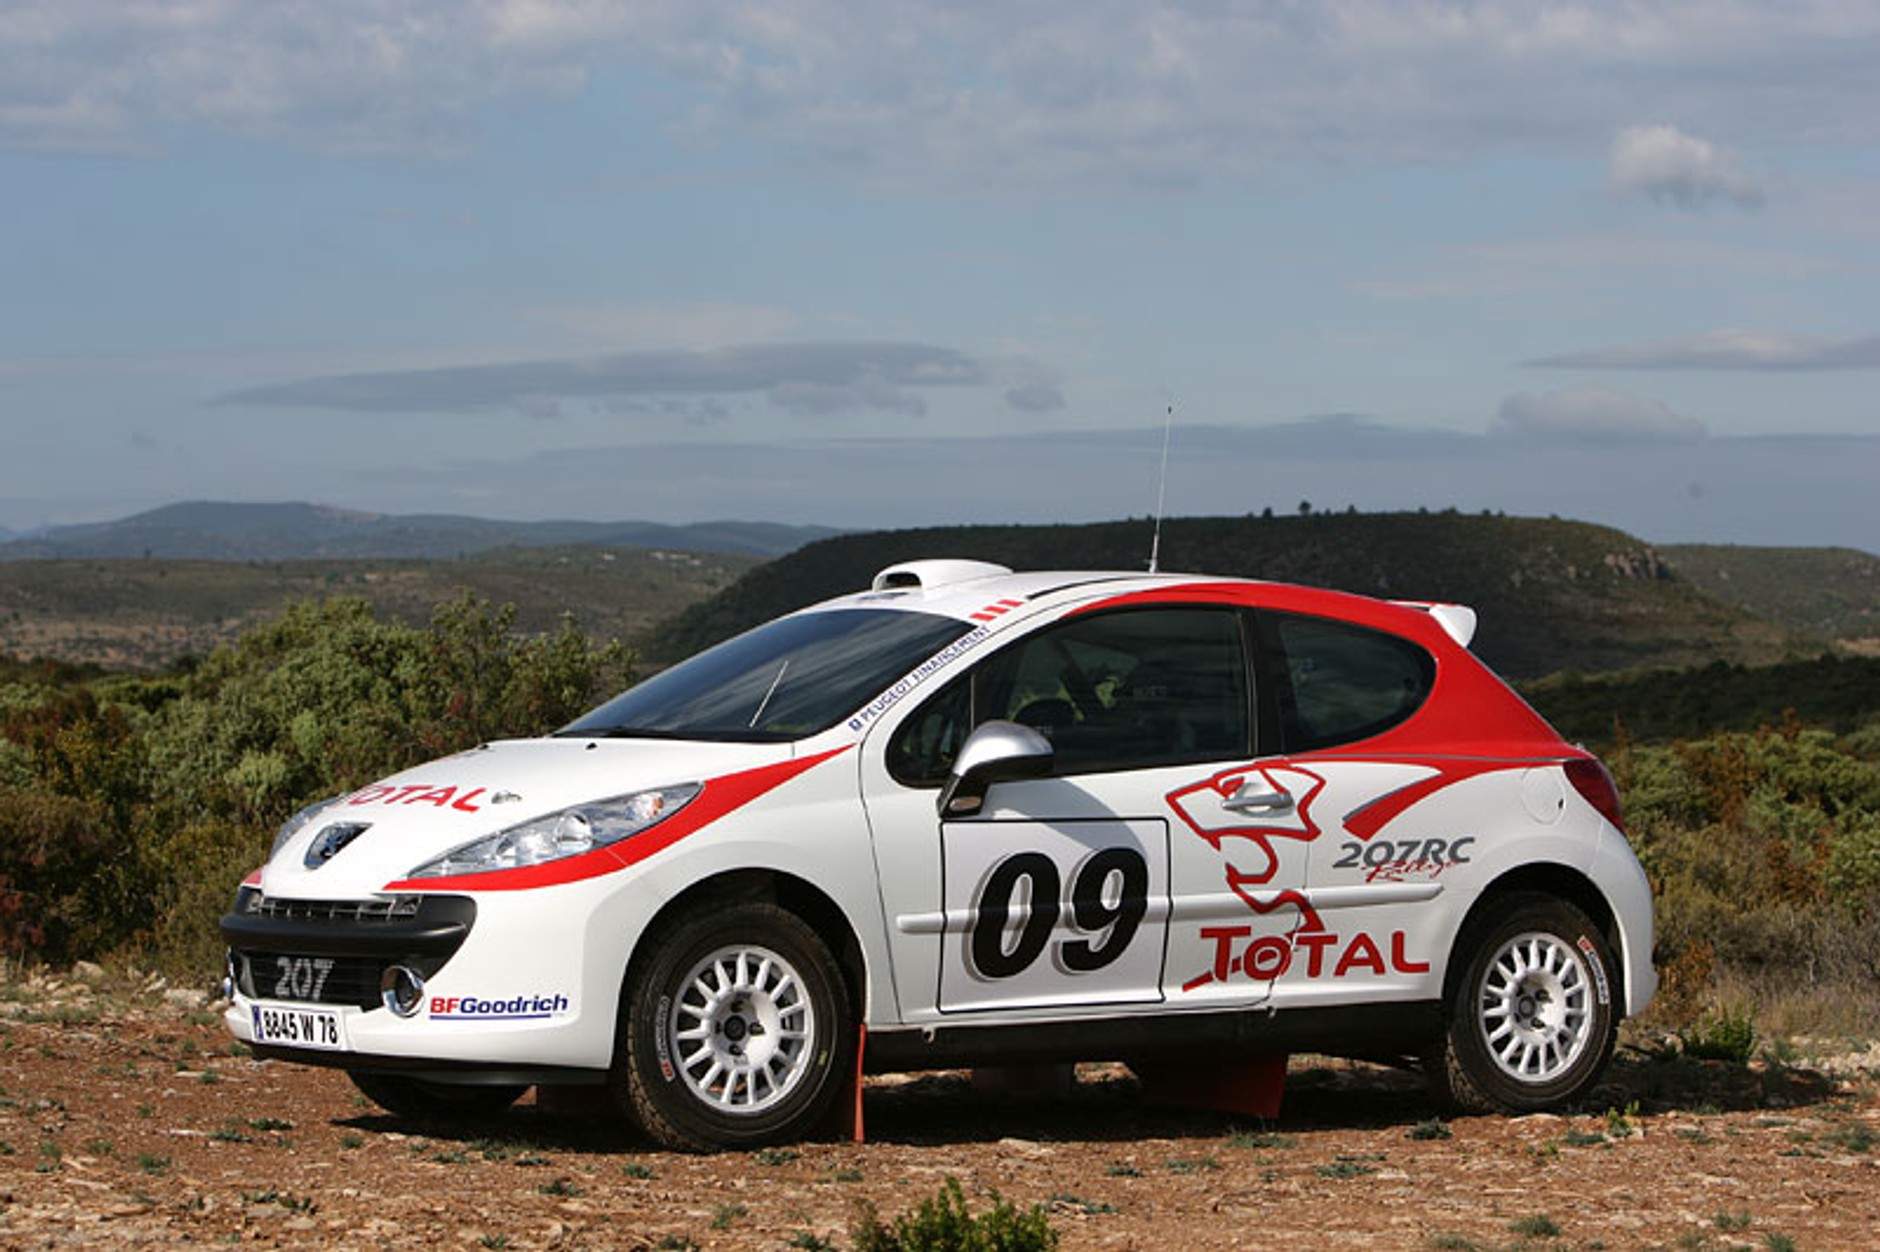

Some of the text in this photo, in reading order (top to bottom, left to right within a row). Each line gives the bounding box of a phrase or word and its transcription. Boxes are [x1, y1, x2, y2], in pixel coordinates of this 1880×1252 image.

[1332, 836, 1475, 868] 207RC
[961, 846, 1149, 983] 09
[1200, 926, 1430, 982] TOTAL
[275, 956, 335, 1001] 207
[430, 994, 568, 1014] BFGoodrich
[299, 1013, 314, 1042] W
[318, 1014, 338, 1044] 78
